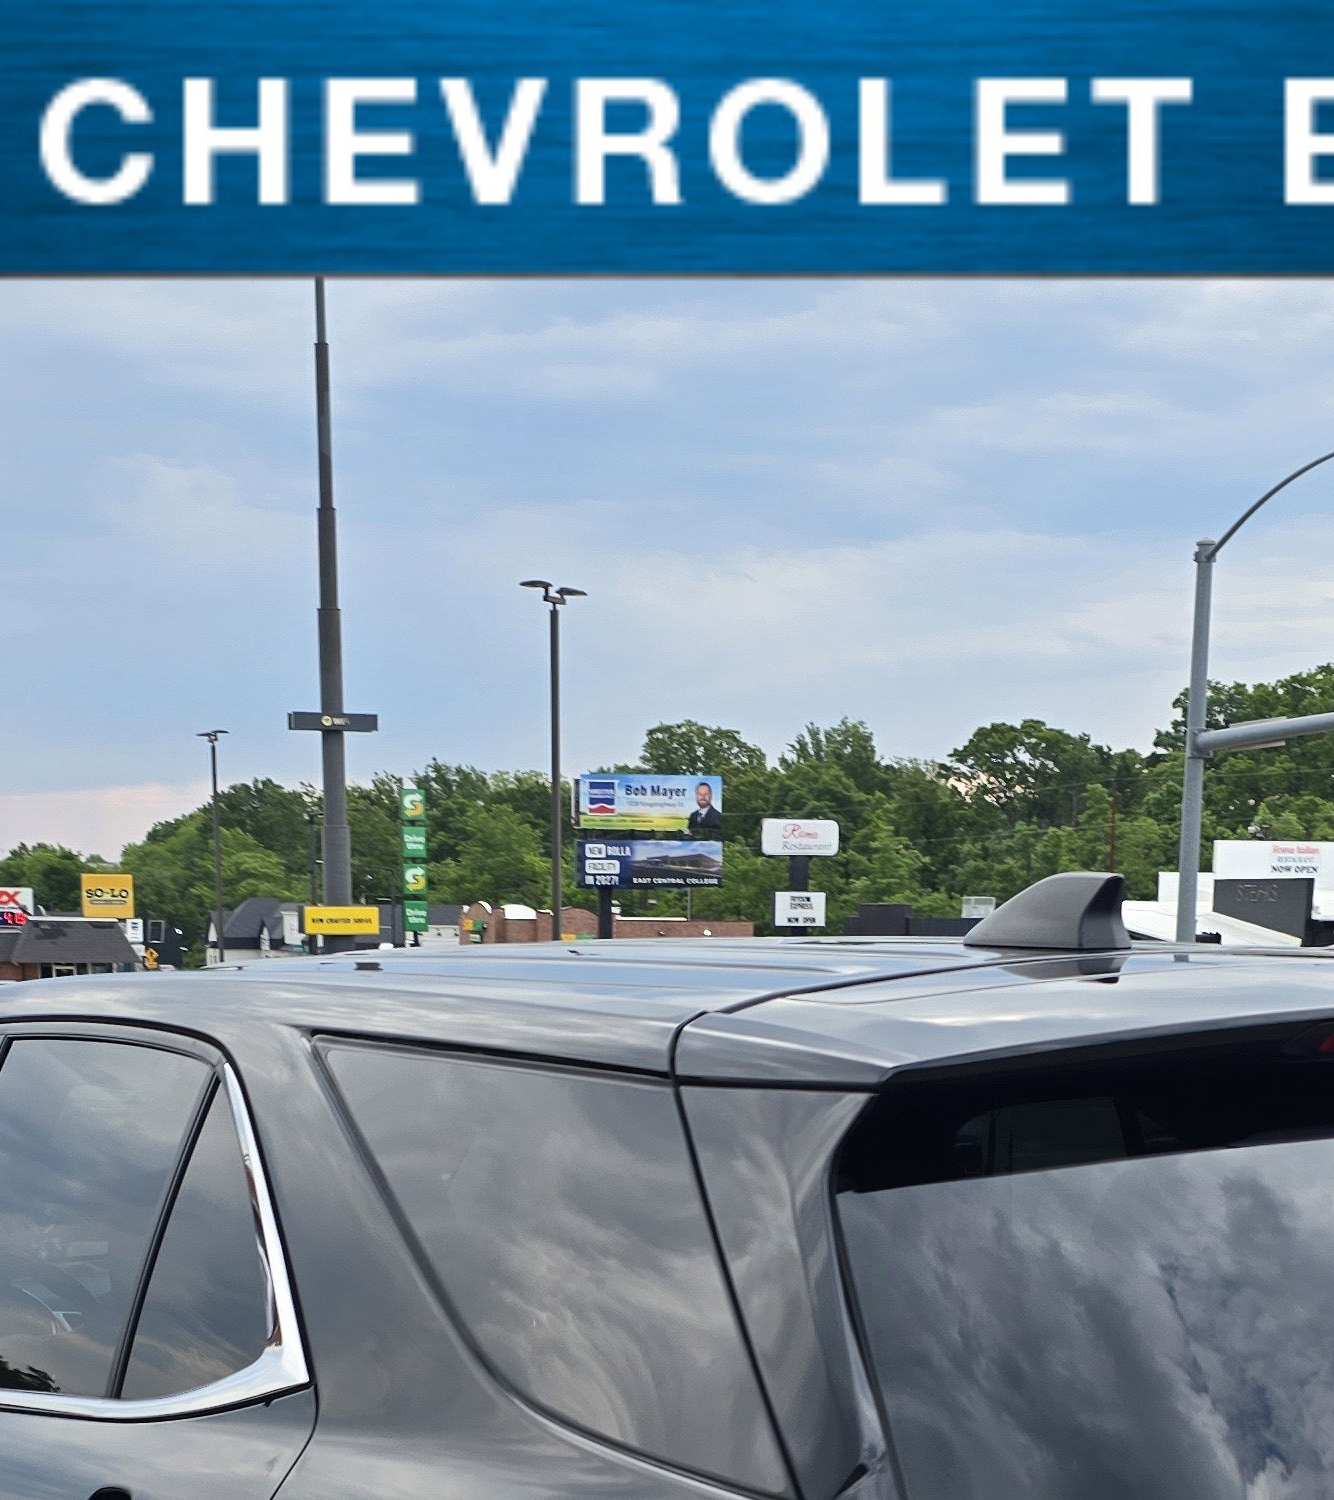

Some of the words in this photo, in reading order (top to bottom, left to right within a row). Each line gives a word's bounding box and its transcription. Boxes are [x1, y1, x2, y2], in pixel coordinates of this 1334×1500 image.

[625, 784, 648, 796] Bob
[651, 785, 688, 799] Mayer
[1271, 865, 1292, 873] NOW
[1294, 865, 1319, 874] OPEN
[85, 888, 129, 899] SO-LO
